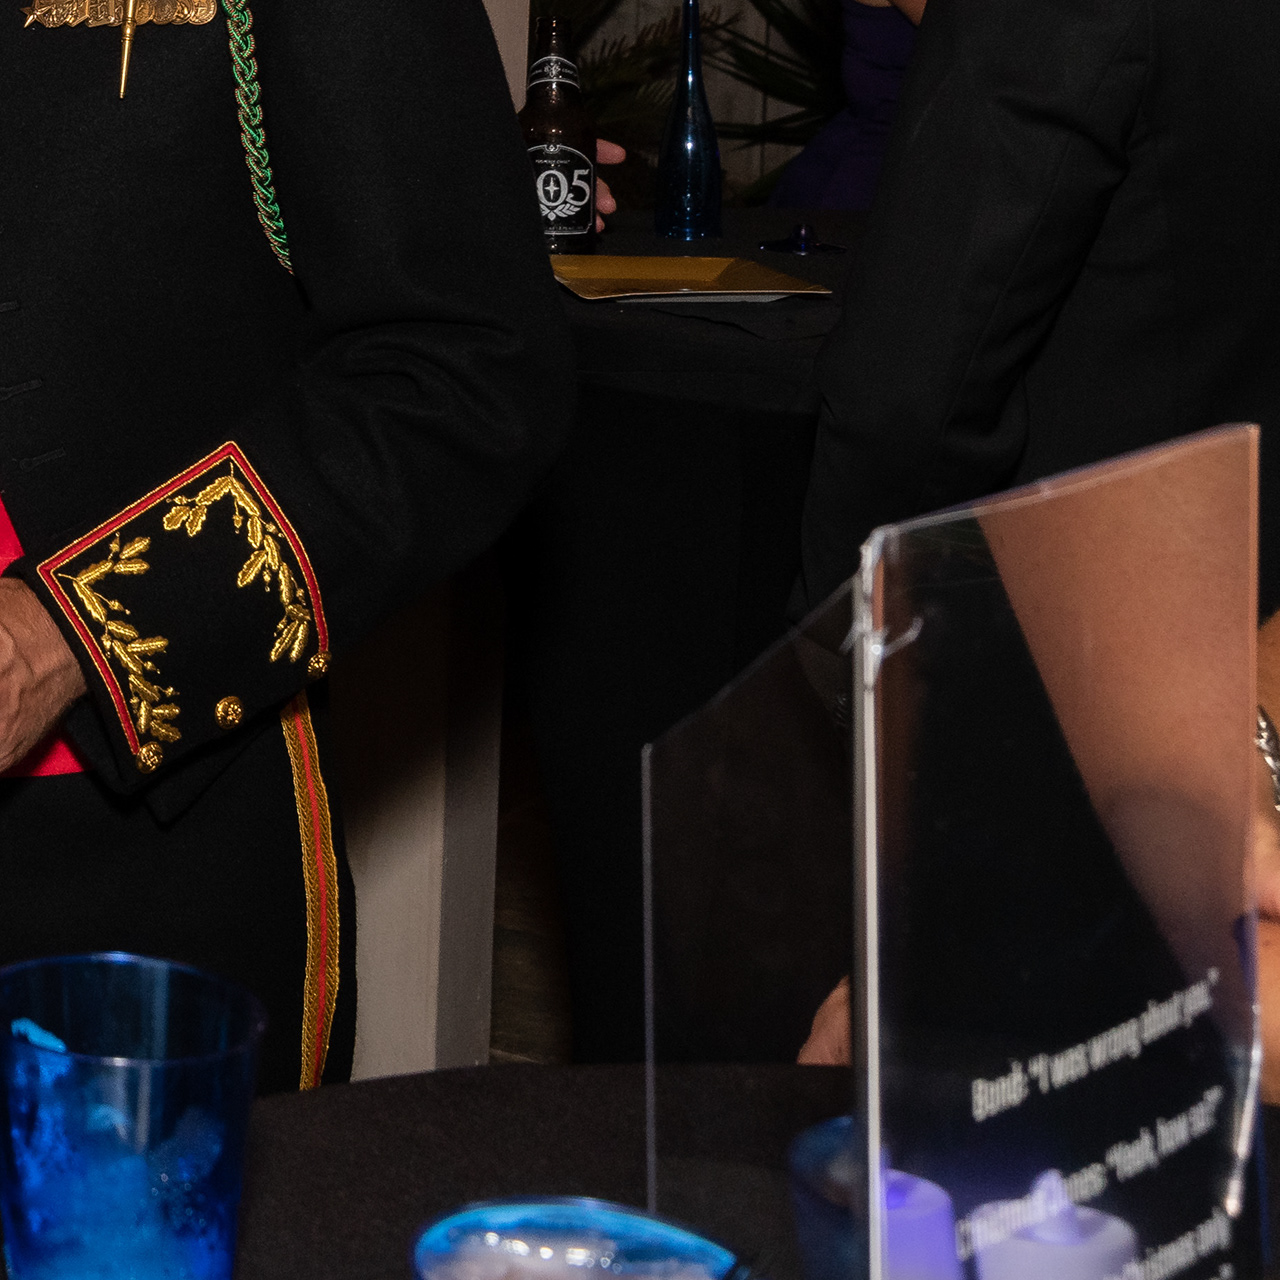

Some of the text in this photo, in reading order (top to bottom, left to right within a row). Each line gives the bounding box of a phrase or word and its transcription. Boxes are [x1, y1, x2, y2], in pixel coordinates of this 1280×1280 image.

[536, 169, 591, 206] 05
[972, 1060, 1029, 1122] Bond:
[1050, 1042, 1089, 1089] was
[1090, 1017, 1141, 1071] wrong
[1141, 991, 1183, 1045] about
[1156, 1116, 1189, 1158] how
